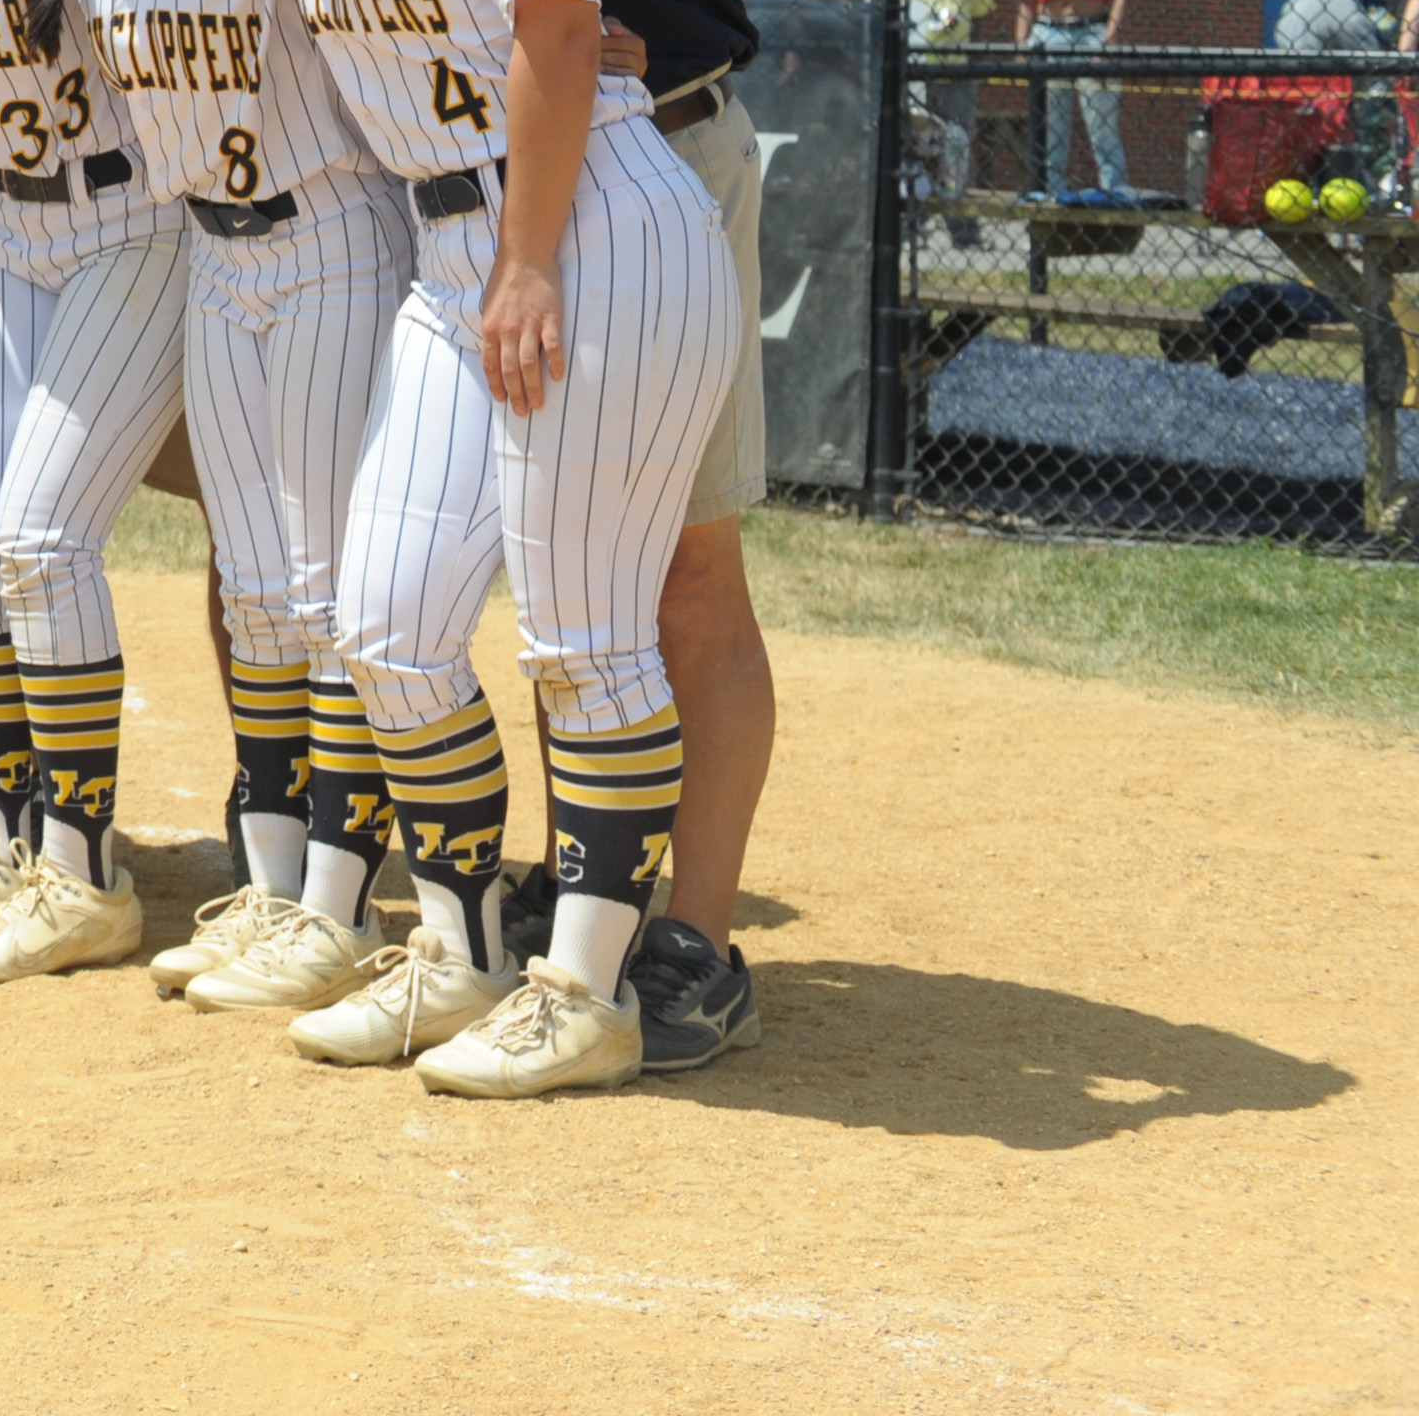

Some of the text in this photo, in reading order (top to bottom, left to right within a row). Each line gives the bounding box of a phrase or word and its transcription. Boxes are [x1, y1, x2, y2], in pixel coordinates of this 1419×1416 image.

[110, 9, 261, 95] CLIPPERS
[427, 56, 492, 134] 4
[219, 125, 261, 200] 8
[50, 770, 116, 818] LC
[412, 822, 504, 876] LC
